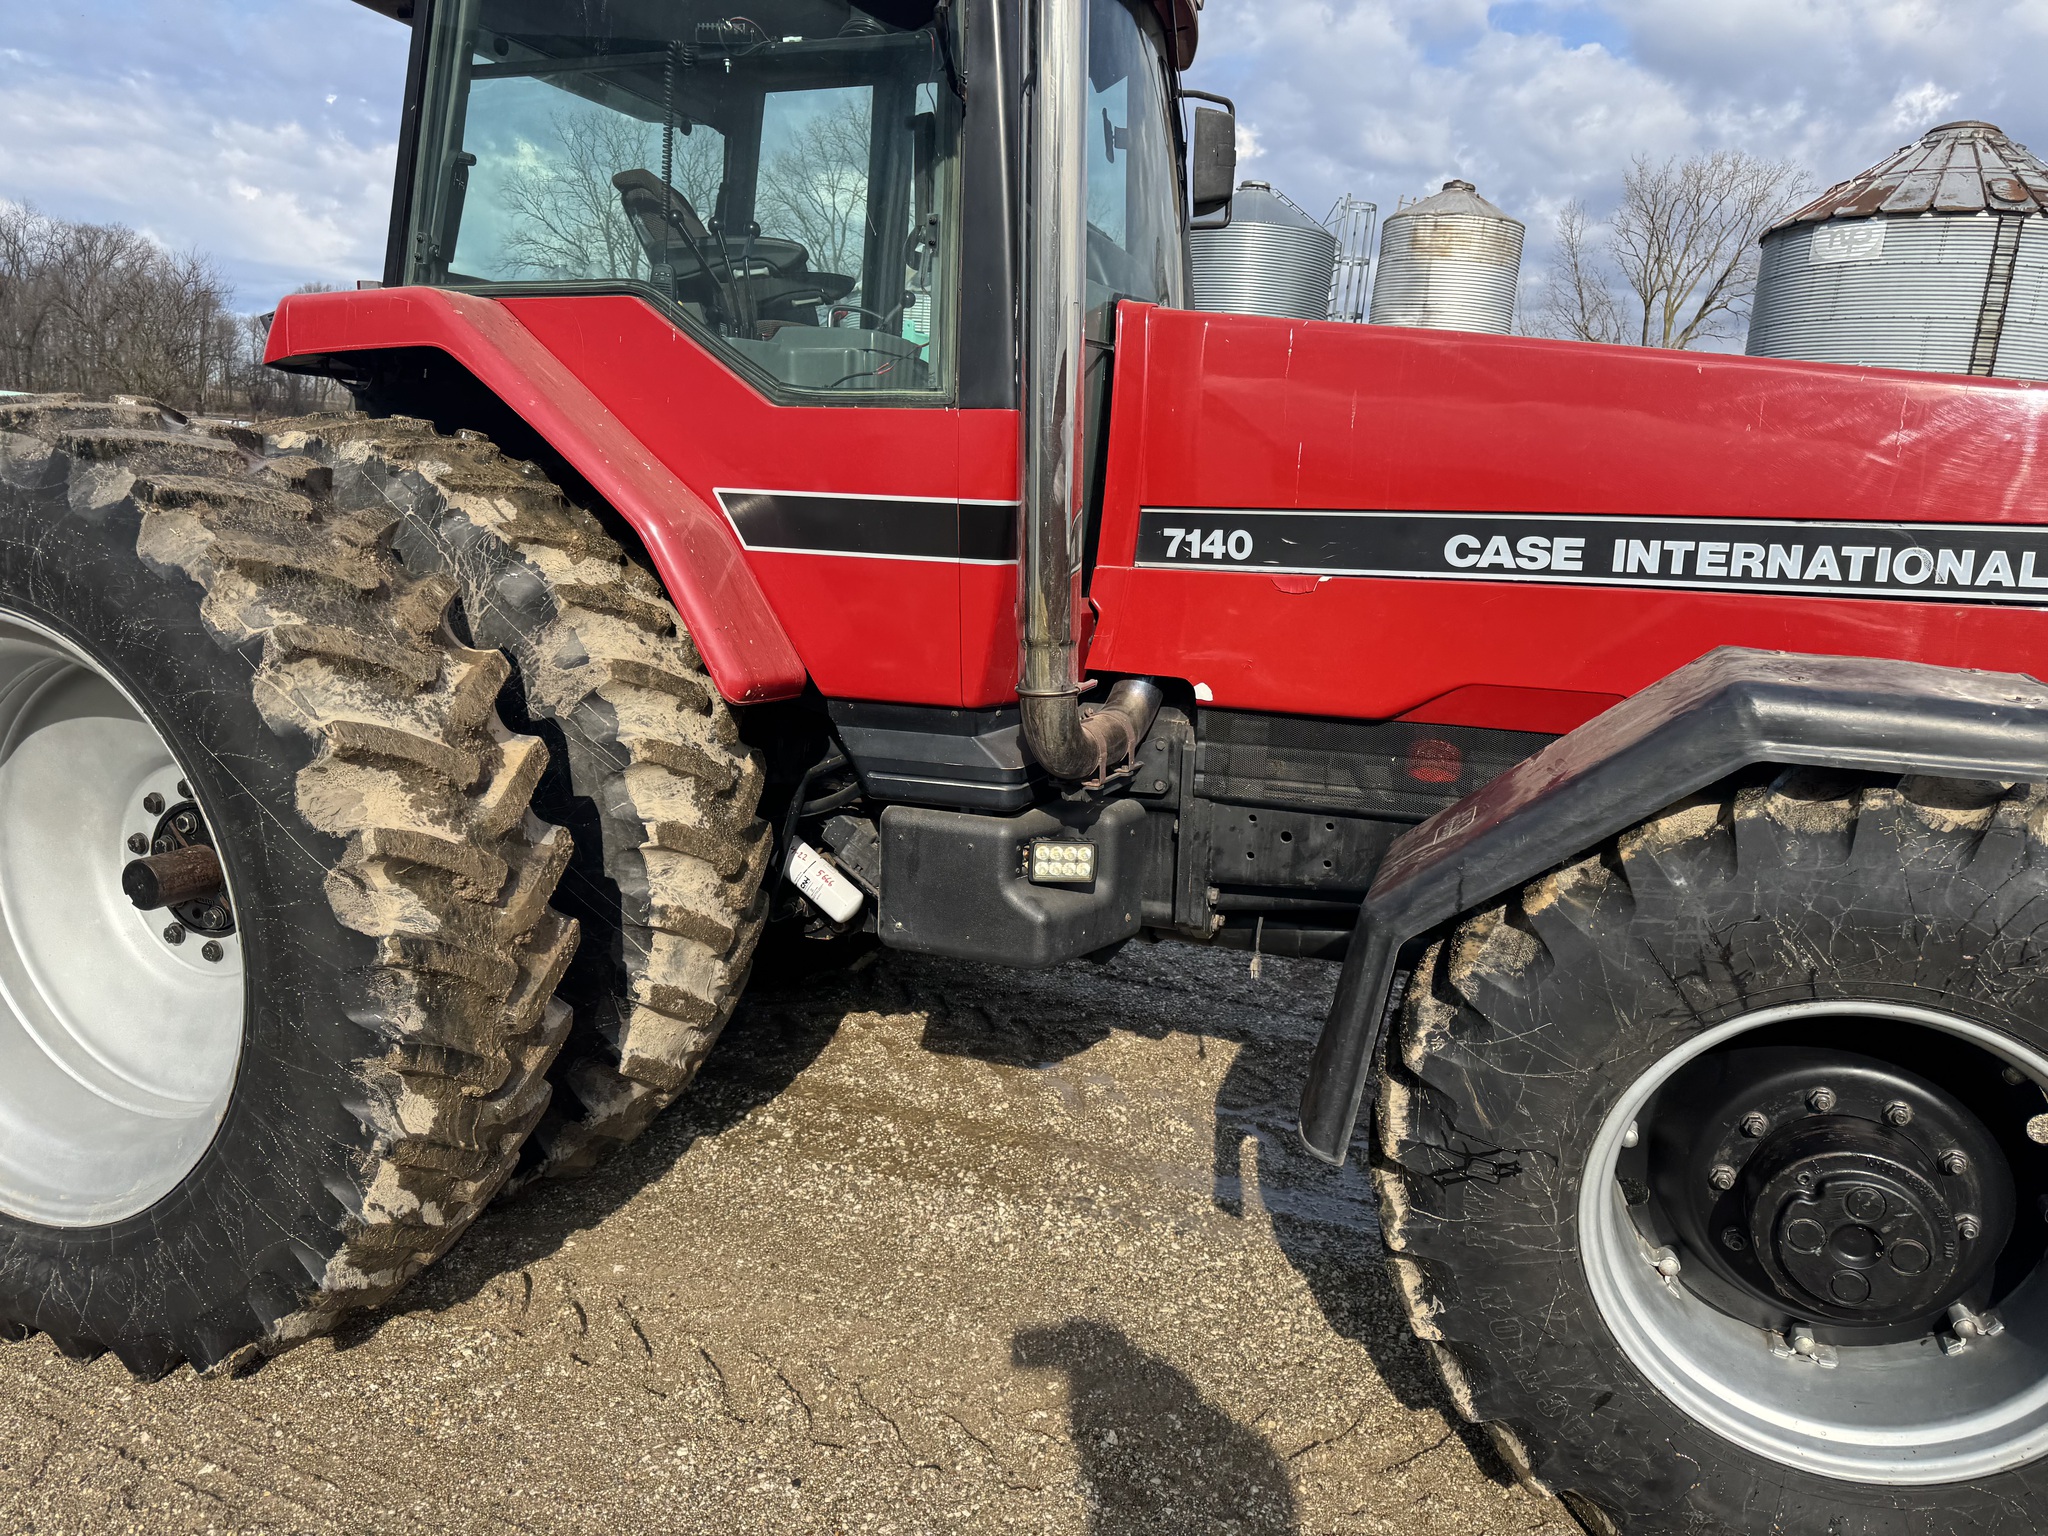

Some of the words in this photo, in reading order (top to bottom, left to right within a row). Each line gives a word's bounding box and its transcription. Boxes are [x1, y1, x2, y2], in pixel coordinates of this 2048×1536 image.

[1163, 528, 1254, 561] 7140
[1443, 534, 1586, 571] CASE
[1611, 538, 2048, 587] INTERNATIONAL
